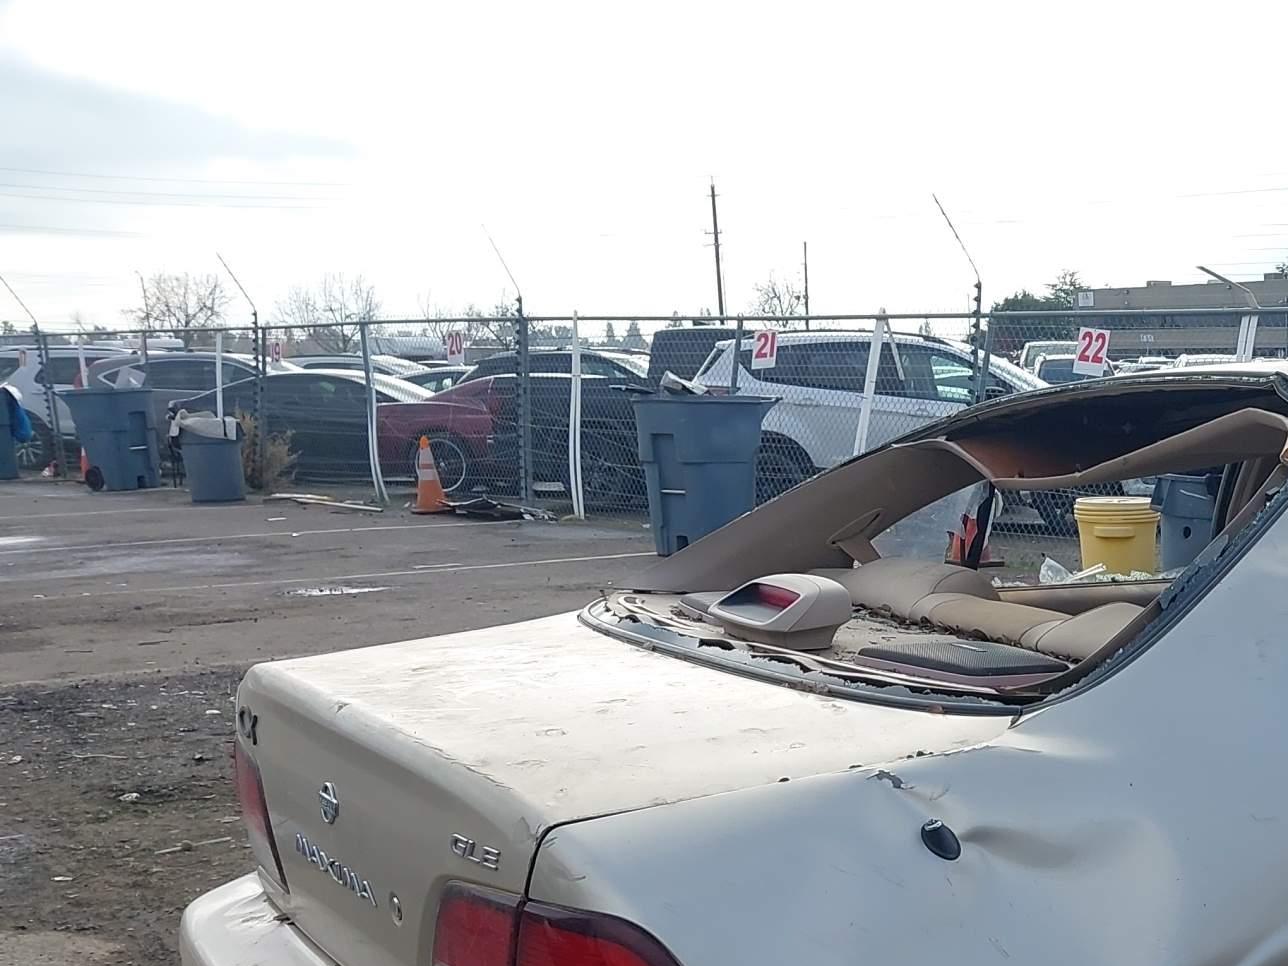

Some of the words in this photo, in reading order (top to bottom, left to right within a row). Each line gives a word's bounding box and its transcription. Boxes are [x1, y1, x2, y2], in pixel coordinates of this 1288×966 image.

[271, 342, 281, 363] 19
[448, 332, 462, 355] 20
[755, 332, 776, 359] 21
[1078, 331, 1107, 364] 22
[450, 832, 501, 871] GLE
[296, 832, 378, 908] MAXIMA
